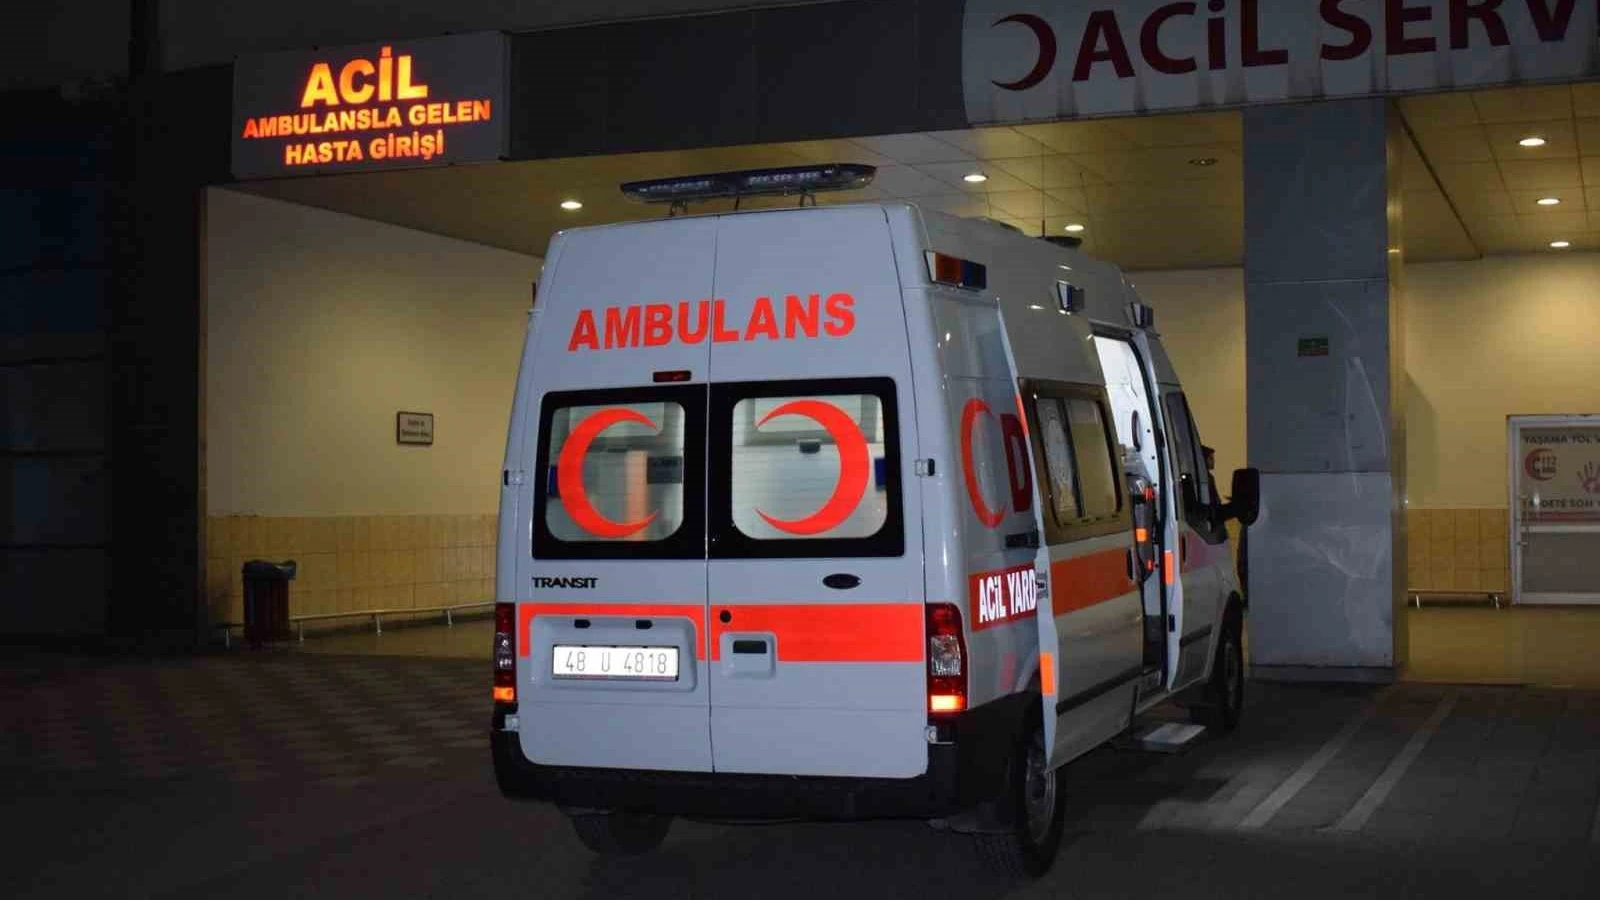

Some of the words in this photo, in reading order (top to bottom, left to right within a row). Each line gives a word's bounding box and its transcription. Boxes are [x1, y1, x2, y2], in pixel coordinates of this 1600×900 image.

[1319, 0, 1600, 61] SERV
[300, 46, 429, 109] ACİL
[242, 106, 403, 139] AMBULANSLA
[408, 99, 492, 126] GELEN
[284, 138, 364, 166] HASTA
[369, 129, 445, 161] GİRİŞİ
[567, 293, 857, 352] AMBULANS
[532, 576, 599, 589] TRANSIT
[565, 651, 586, 673] 48
[601, 651, 611, 673] U
[623, 652, 668, 674] 4818
